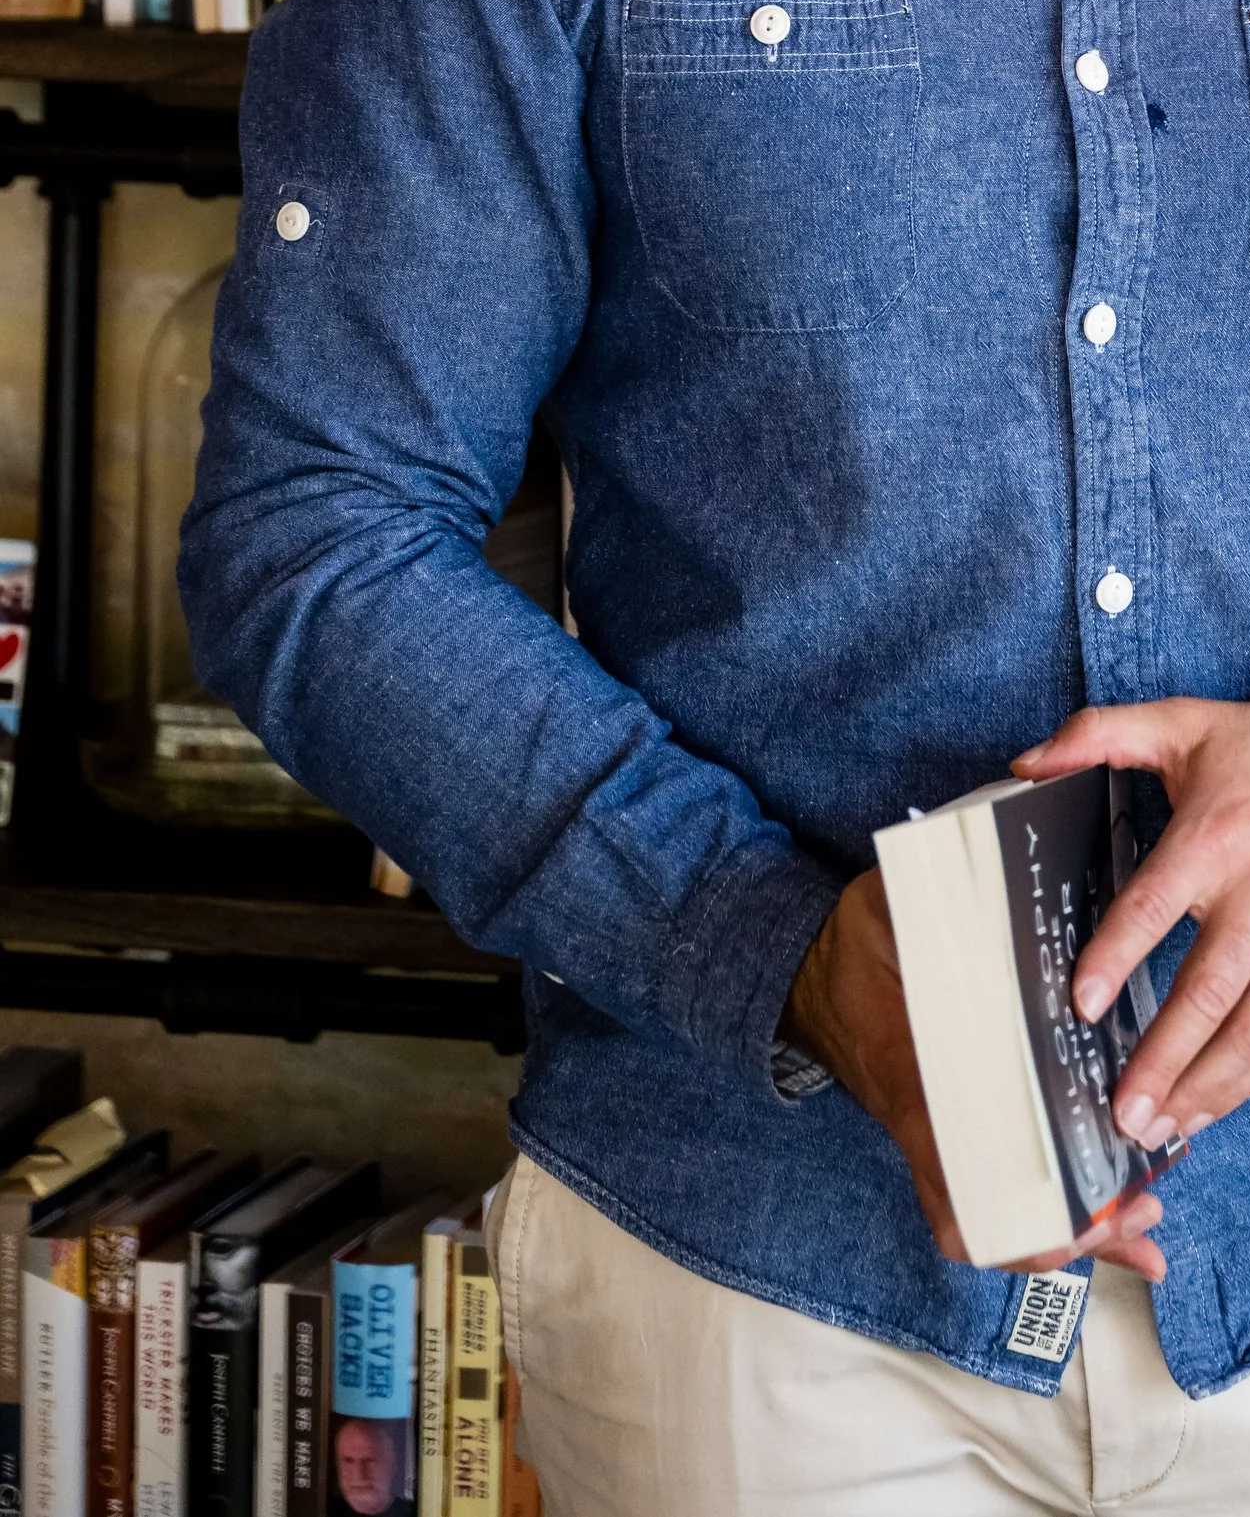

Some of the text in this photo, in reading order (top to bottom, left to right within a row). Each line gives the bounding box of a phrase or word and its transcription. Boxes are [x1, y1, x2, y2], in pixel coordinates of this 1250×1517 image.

[140, 1304, 155, 1342] THIS
[335, 1294, 366, 1389] SACKS
[362, 1283, 399, 1399] OLIVER
[1013, 1275, 1052, 1348] UNION
[1039, 1281, 1071, 1339] MADE
[155, 1279, 176, 1437] TRICKSTER MAKES
[292, 1321, 313, 1489] CHOICES WE MAKE
[421, 1327, 441, 1457] PHANTASTES
[452, 1415, 476, 1499] ALONE
